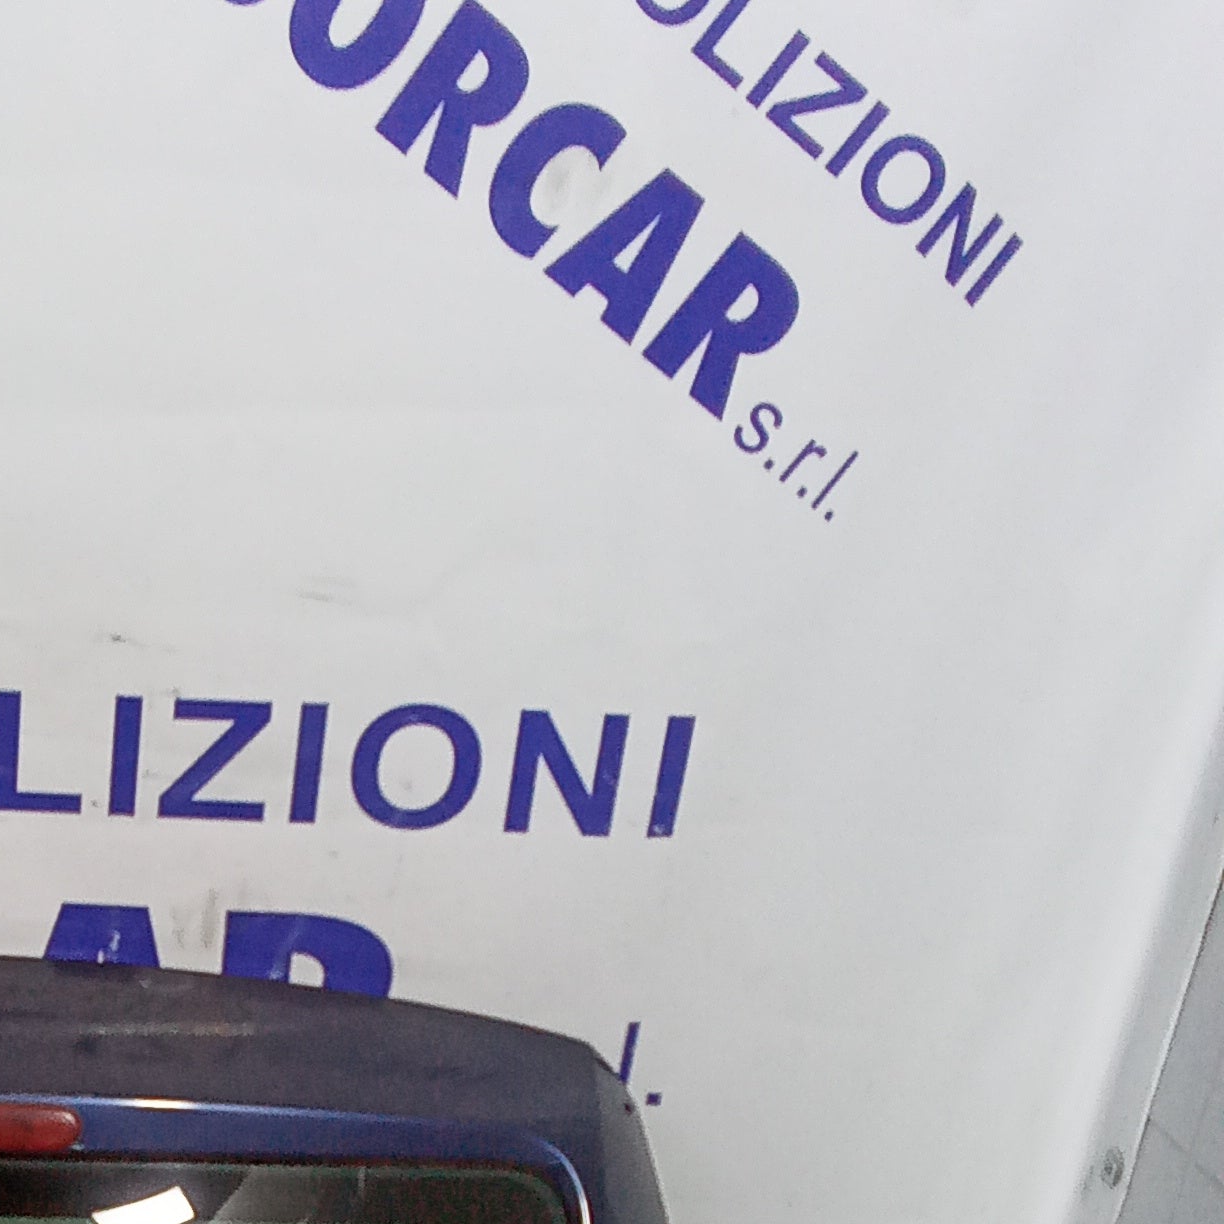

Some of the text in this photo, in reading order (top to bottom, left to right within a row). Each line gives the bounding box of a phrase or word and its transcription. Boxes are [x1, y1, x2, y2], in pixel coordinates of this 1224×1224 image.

[224, 0, 859, 523] ORCAR s.r.l.
[634, 0, 1024, 309] LIZIONI
